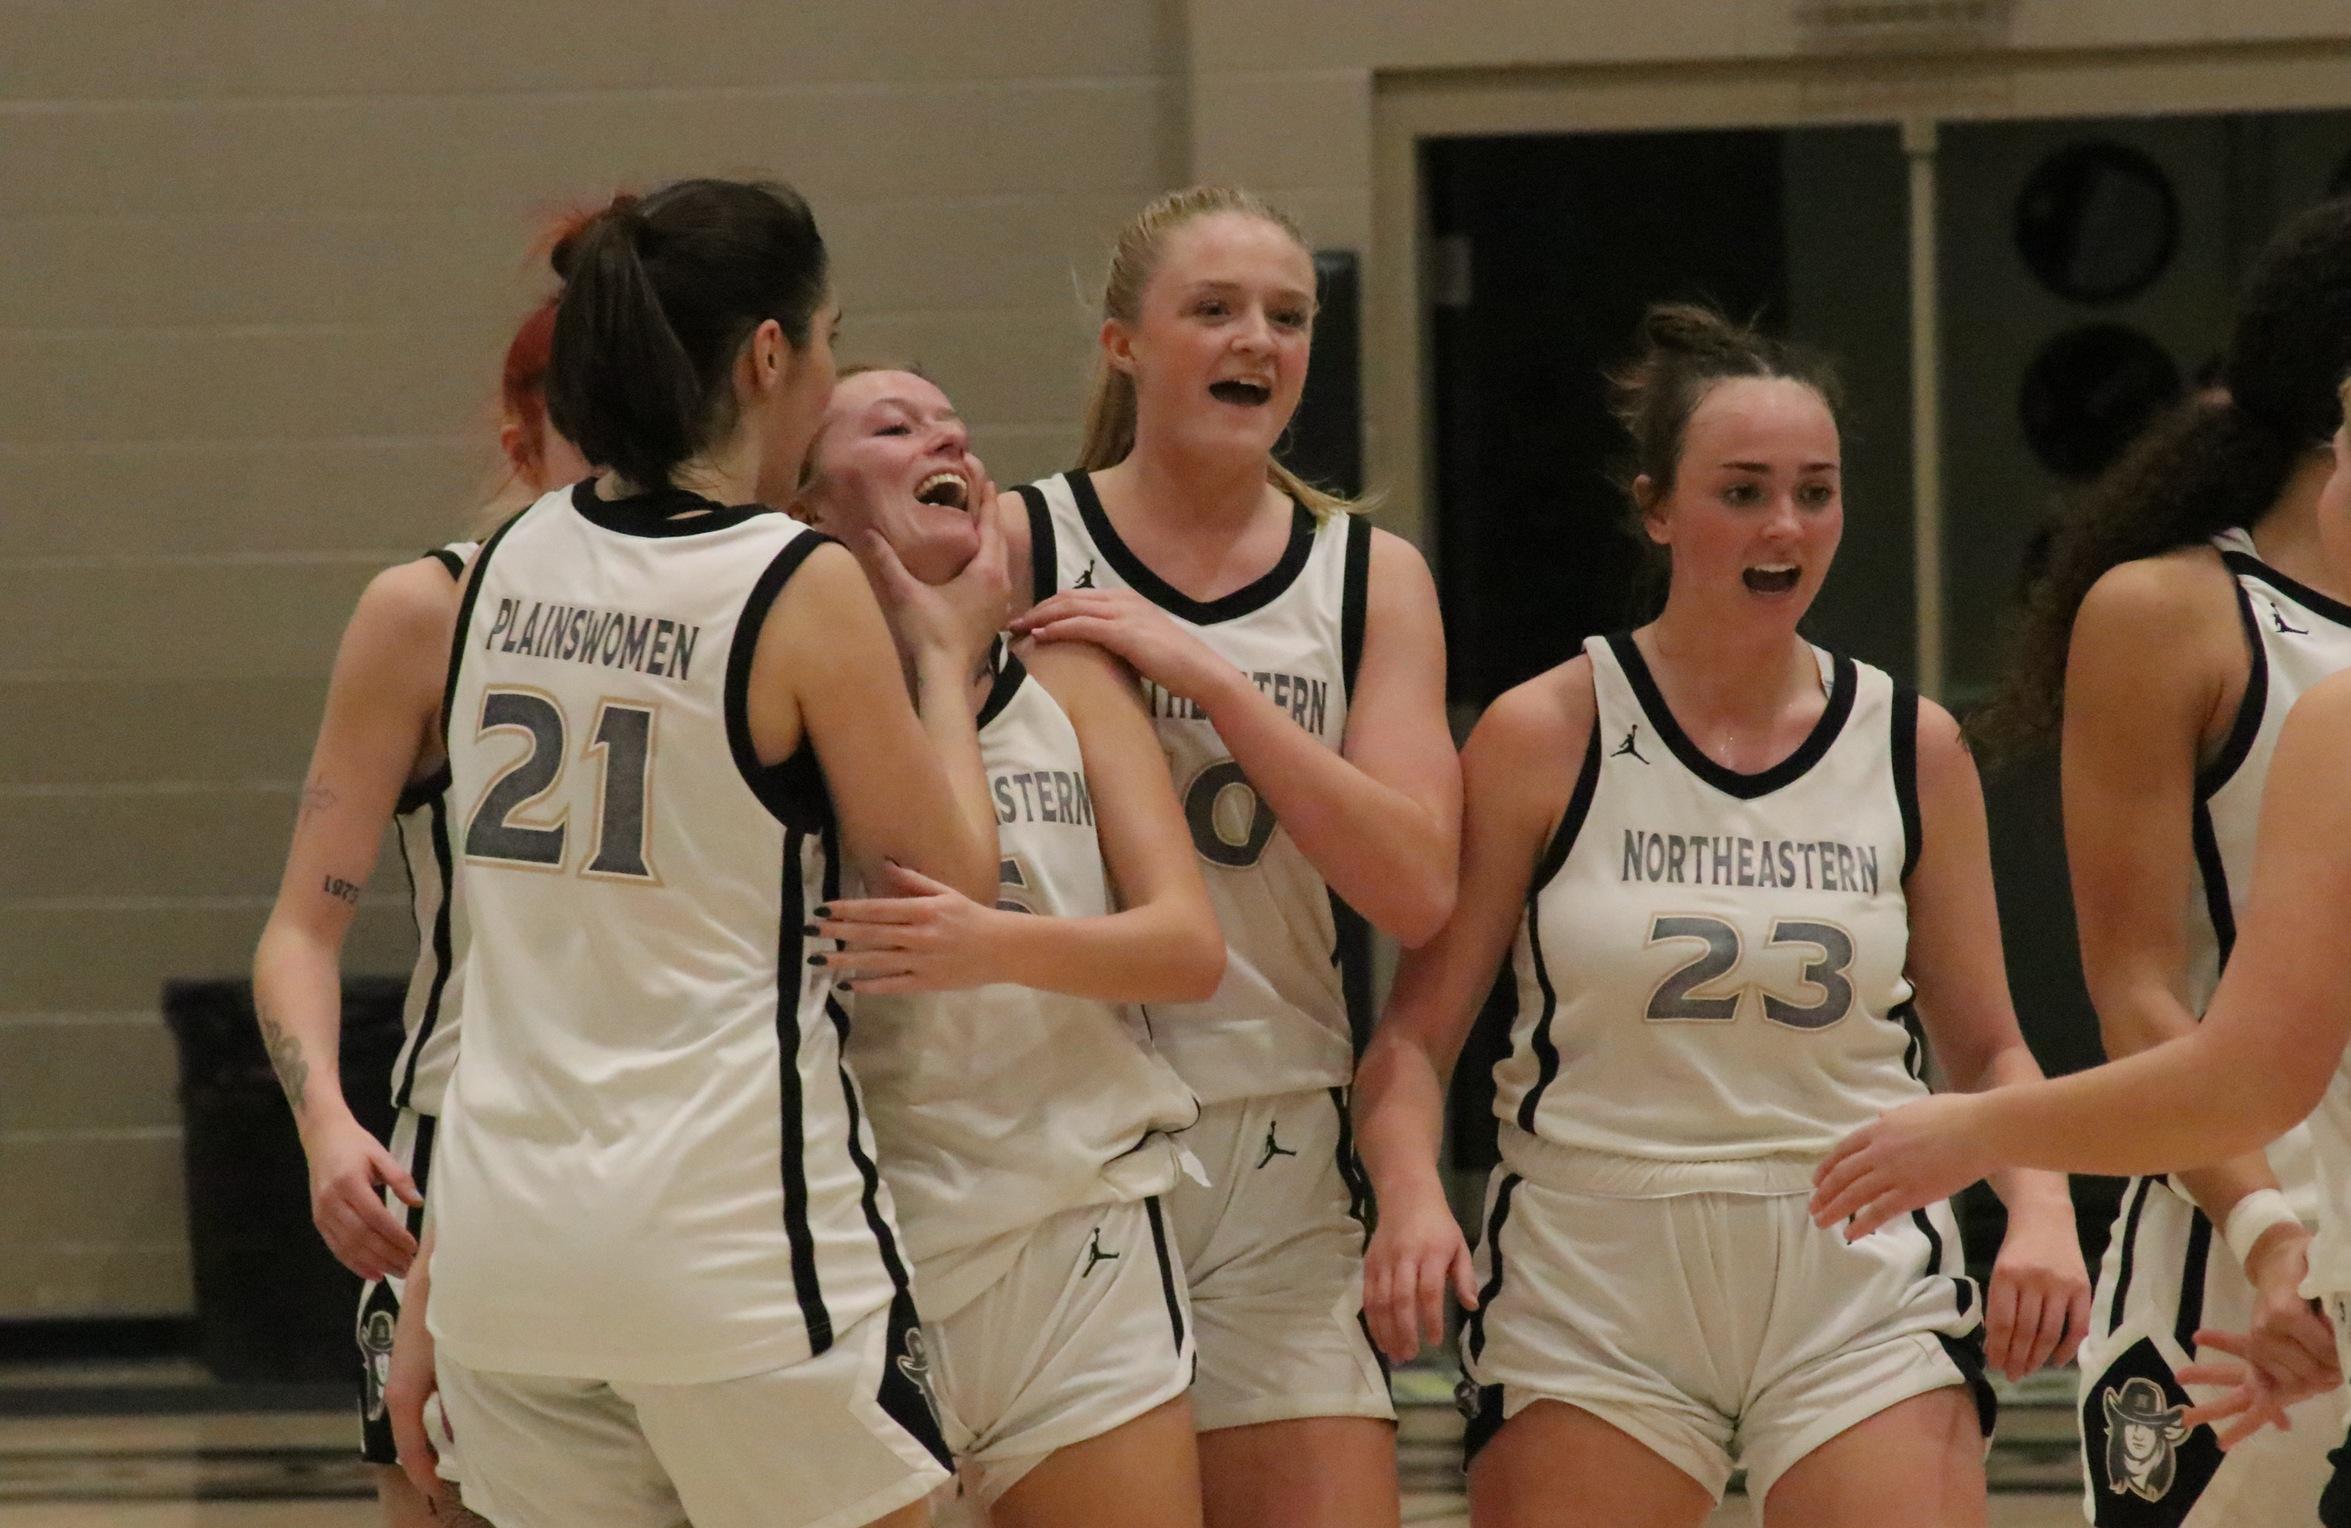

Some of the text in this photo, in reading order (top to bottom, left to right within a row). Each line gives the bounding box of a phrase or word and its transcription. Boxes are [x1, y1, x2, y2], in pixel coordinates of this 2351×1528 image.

[486, 598, 700, 681] PLAINSWOMEN
[464, 683, 664, 888] 21
[994, 770, 1093, 827] STERN
[1622, 829, 1879, 897] NORTHEASTERN
[1644, 912, 1857, 1034] 23
